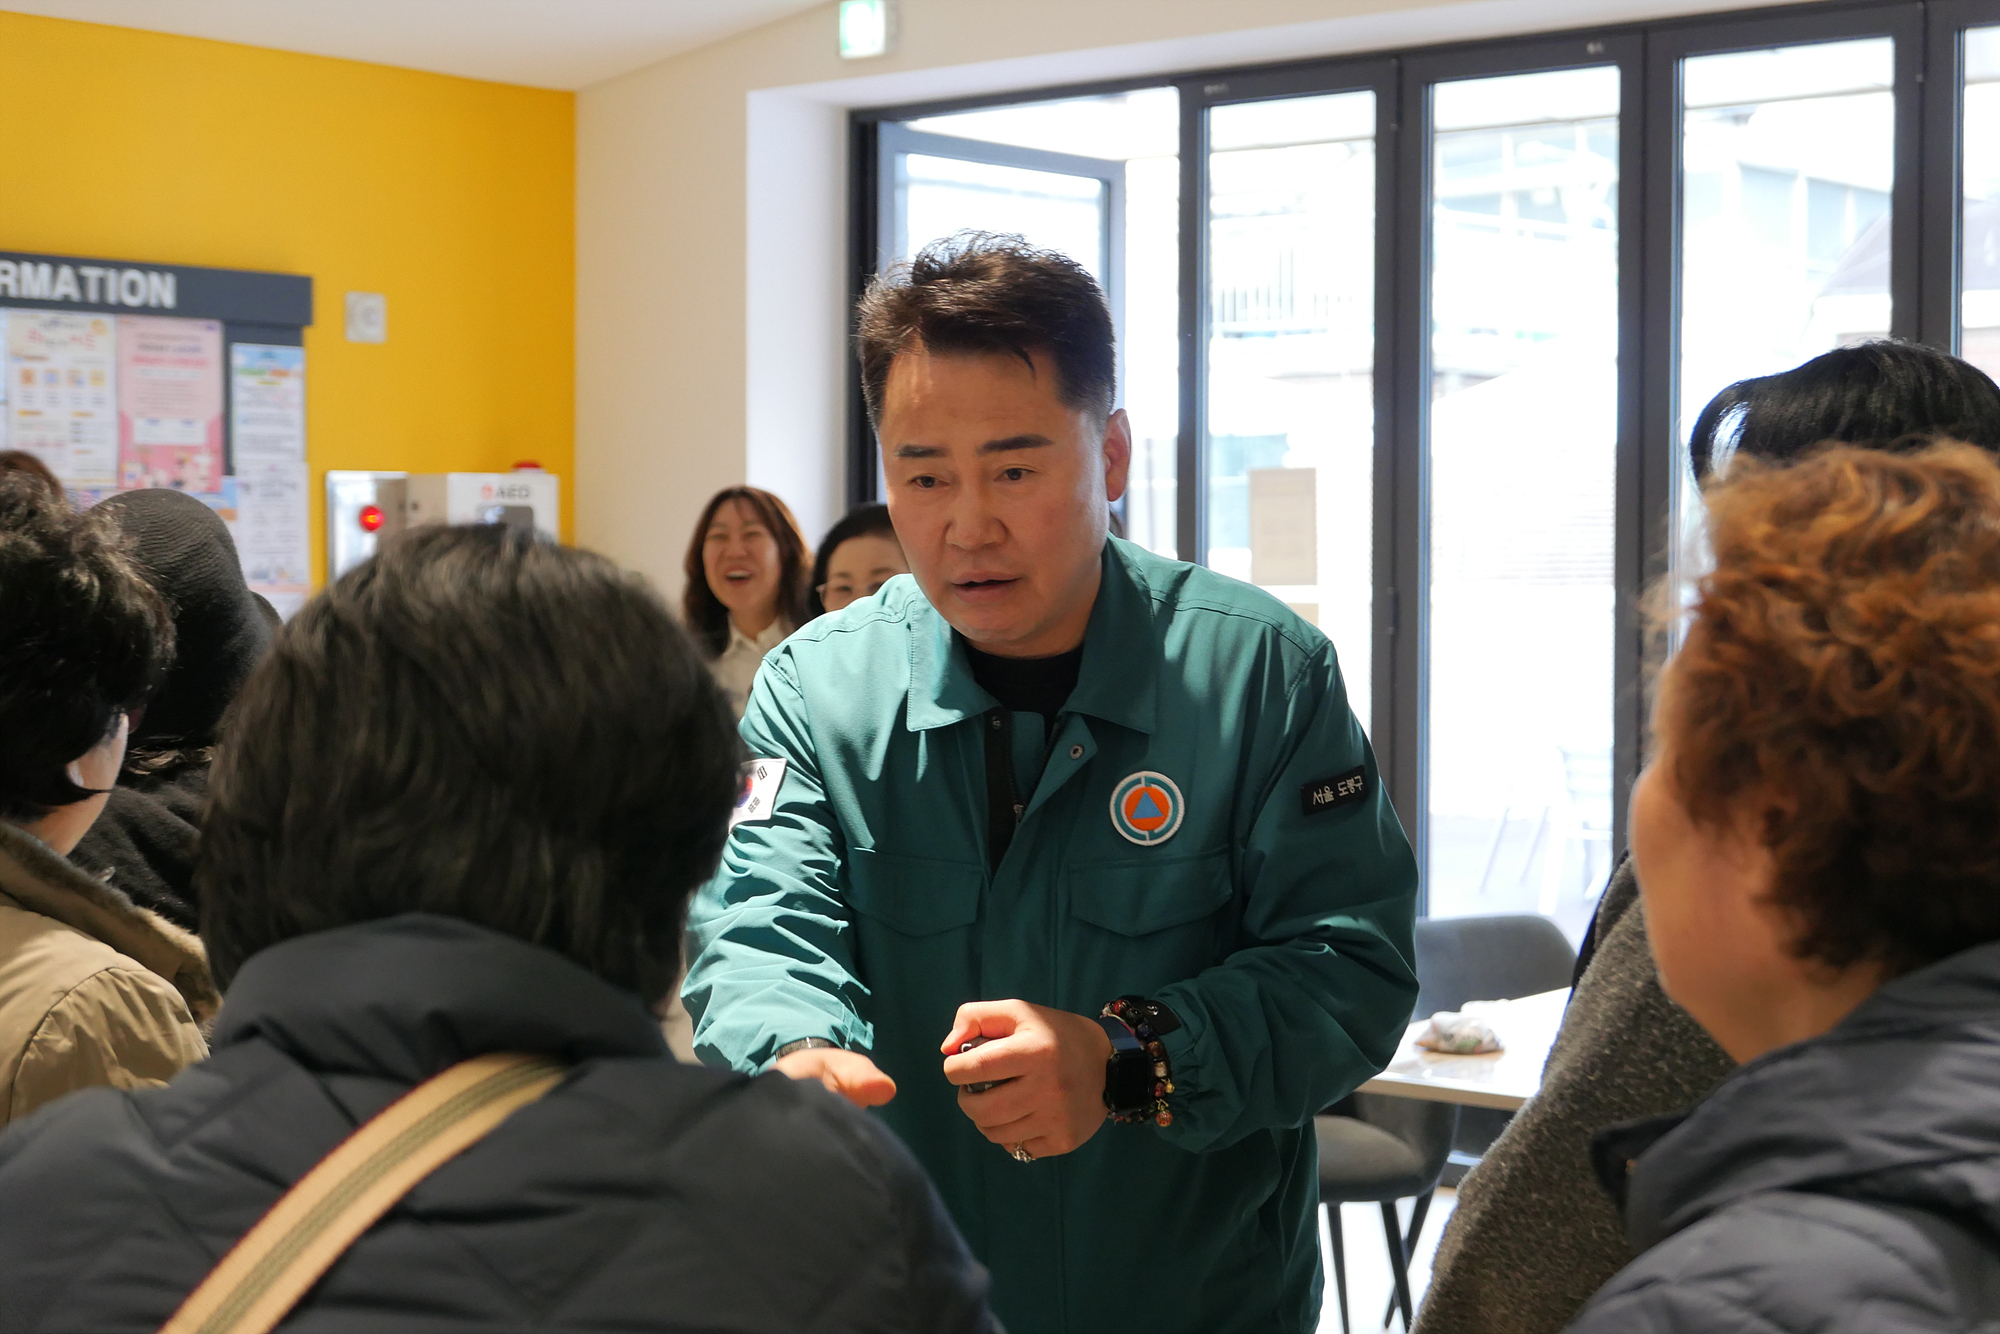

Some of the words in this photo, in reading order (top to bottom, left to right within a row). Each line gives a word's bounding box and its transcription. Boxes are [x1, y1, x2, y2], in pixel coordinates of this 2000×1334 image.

[495, 484, 530, 499] AED
[1313, 785, 1334, 805] 서울
[1337, 775, 1363, 796] 도봉구
